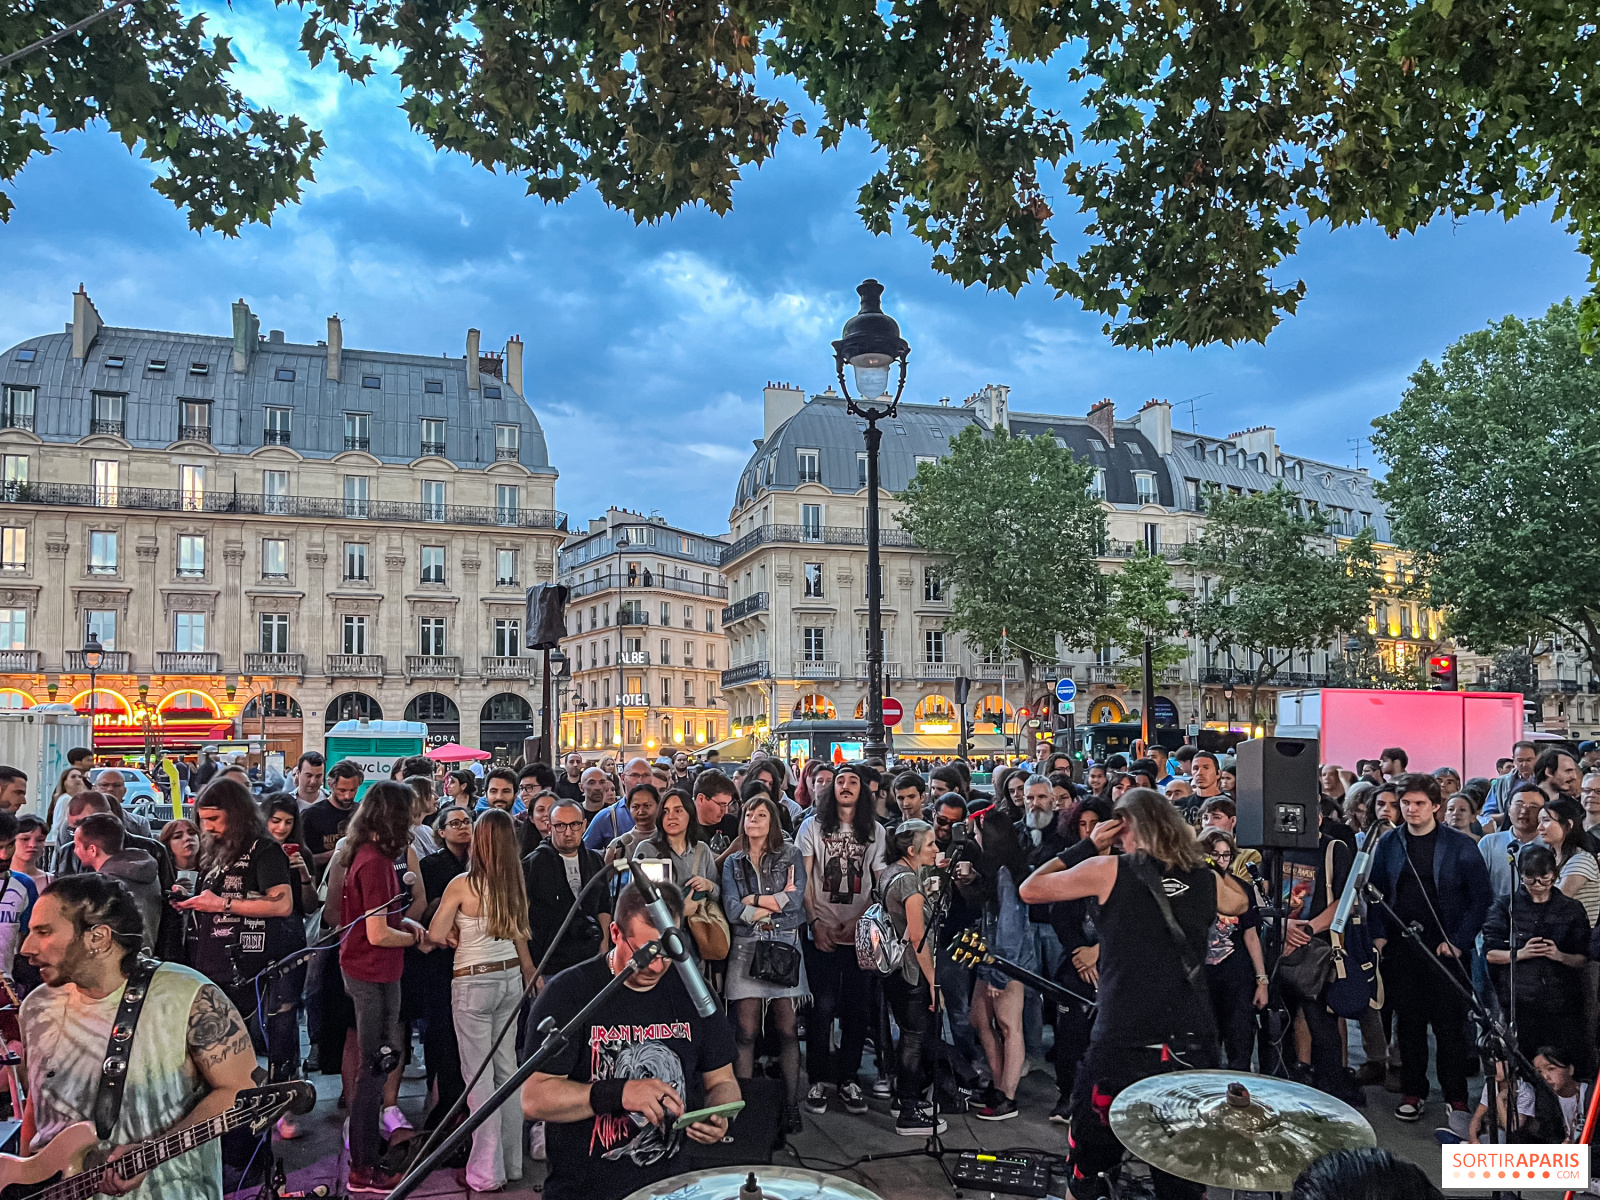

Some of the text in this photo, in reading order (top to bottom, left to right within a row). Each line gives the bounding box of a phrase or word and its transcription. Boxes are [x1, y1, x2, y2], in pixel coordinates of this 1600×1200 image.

[615, 693, 648, 706] HOTEL
[591, 1022, 692, 1045] IRON MAIDEN
